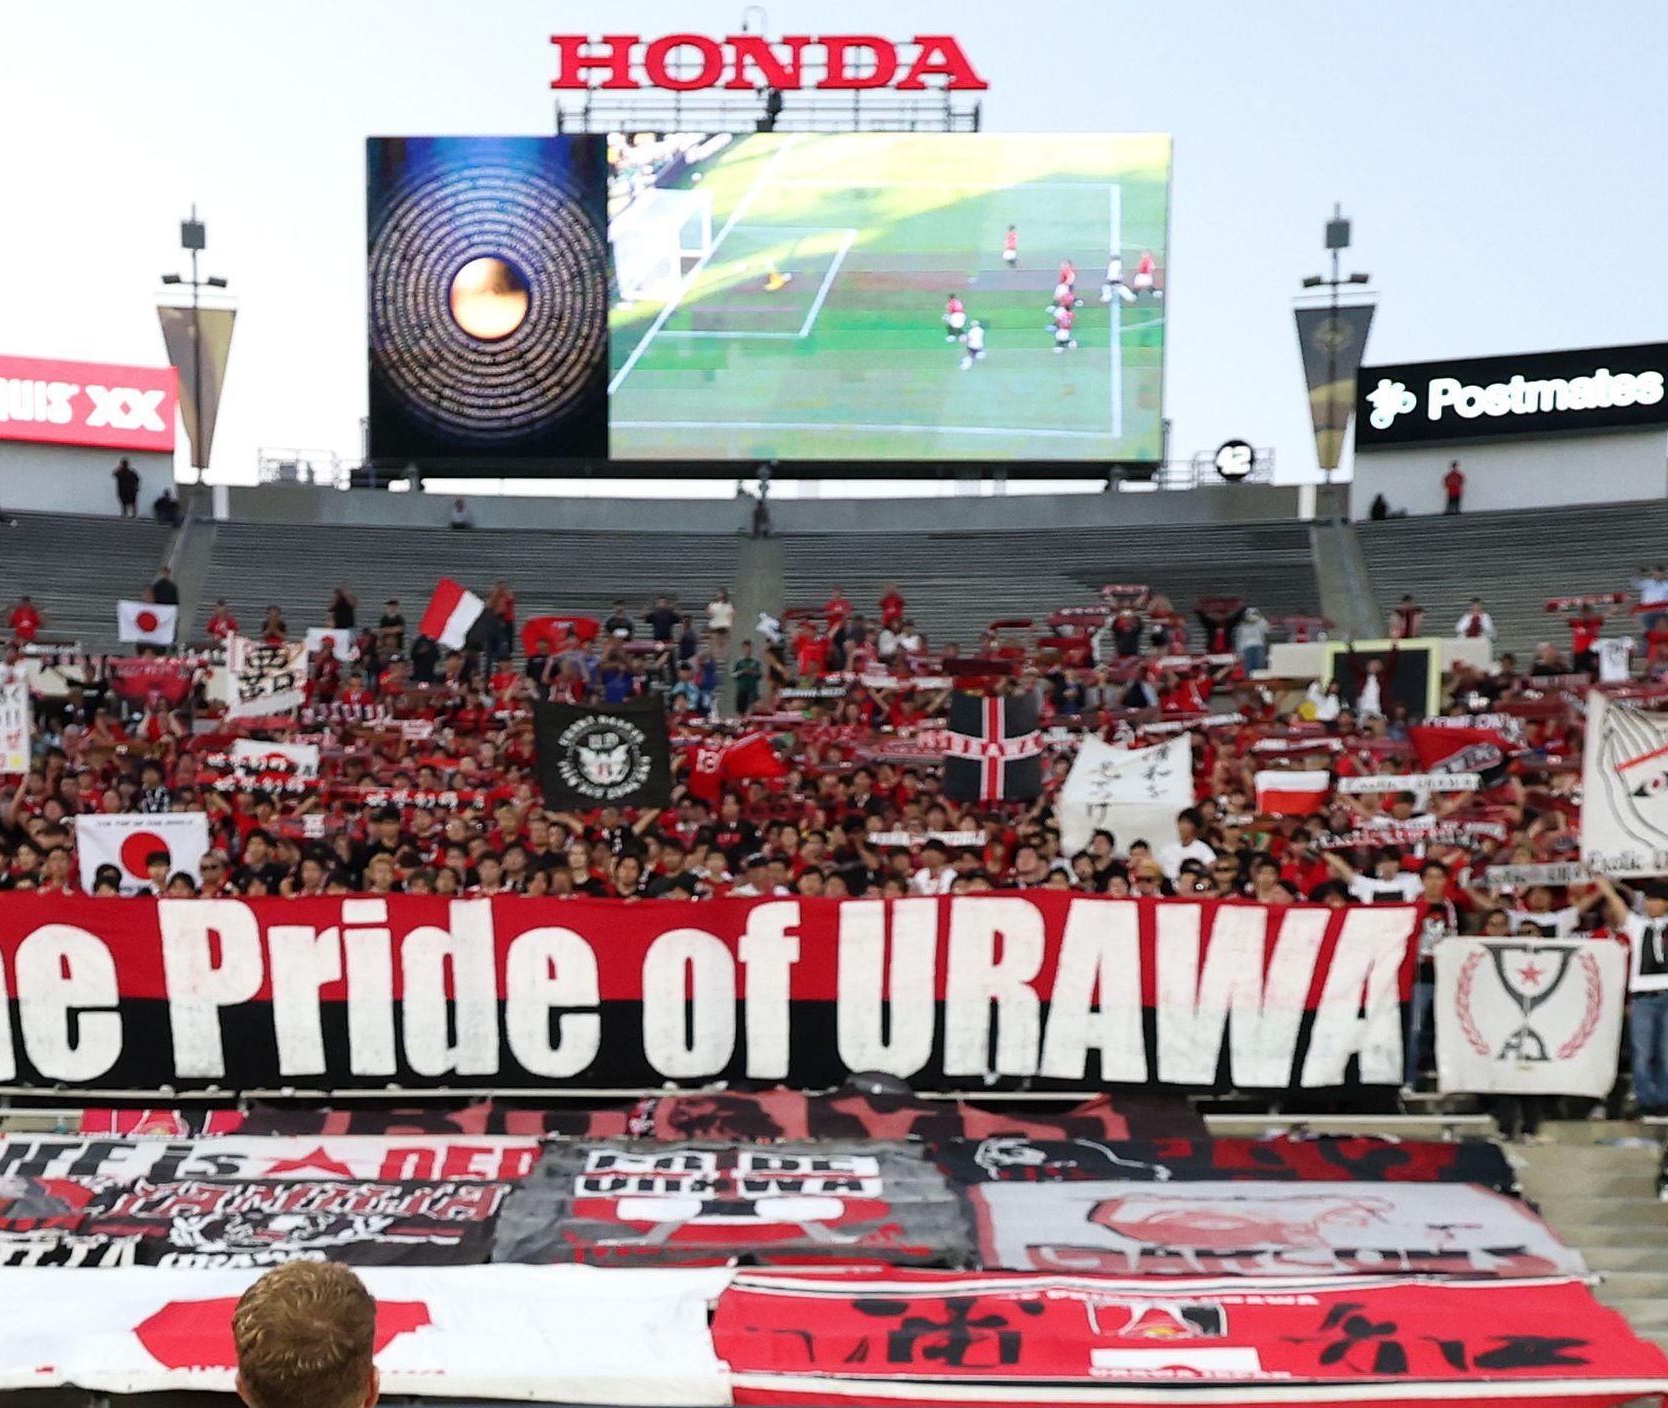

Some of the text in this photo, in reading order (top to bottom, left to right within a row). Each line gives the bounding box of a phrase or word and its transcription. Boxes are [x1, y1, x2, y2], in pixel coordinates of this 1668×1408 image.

[549, 34, 988, 91] HONDA
[85, 384, 166, 433] XX
[1427, 366, 1665, 421] Postmates
[158, 893, 604, 1082] Pride
[640, 898, 804, 1082] of
[832, 893, 1426, 1088] URAWA
